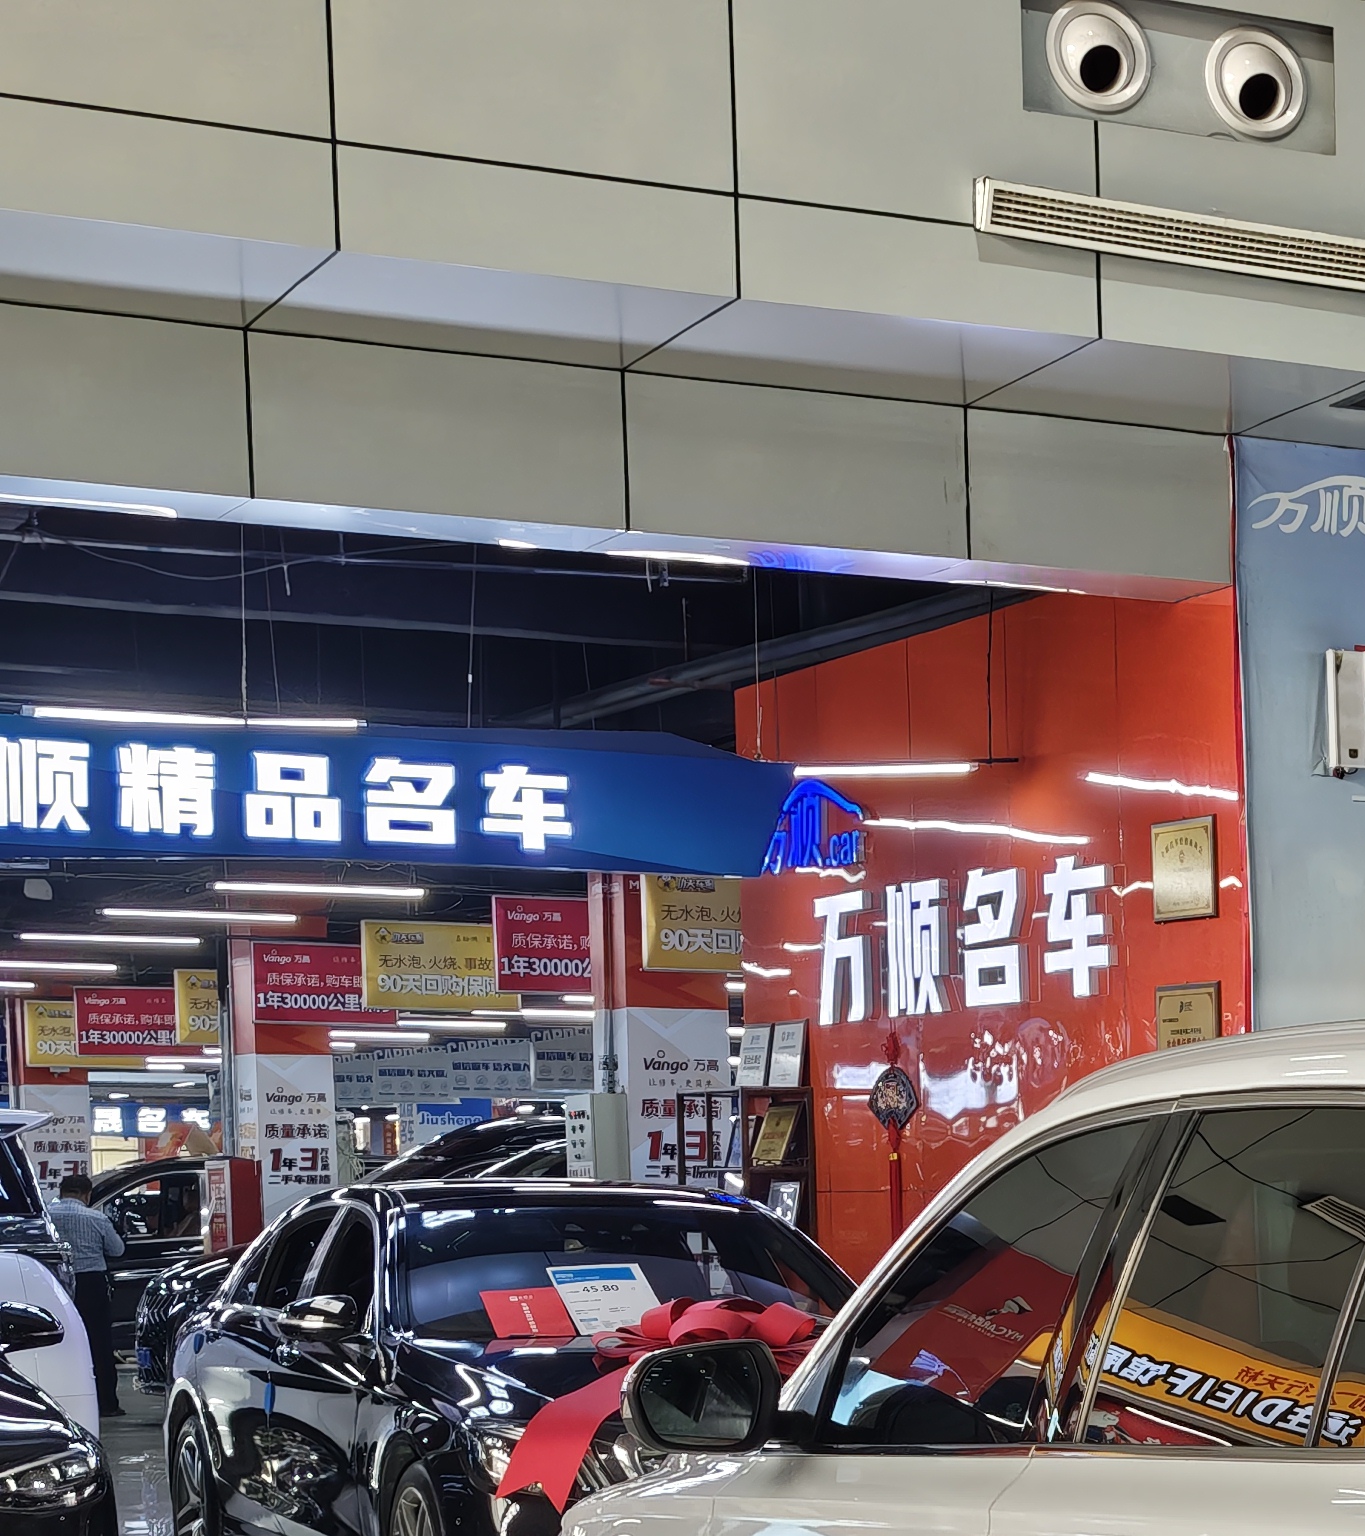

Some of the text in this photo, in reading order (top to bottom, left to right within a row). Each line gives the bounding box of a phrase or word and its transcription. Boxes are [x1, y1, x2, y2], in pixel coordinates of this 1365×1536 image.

[812, 856, 1116, 1026] 万顺名车
[643, 1050, 690, 1075] Vango
[265, 1087, 303, 1106] Vango
[582, 1284, 620, 1294] 45.80
